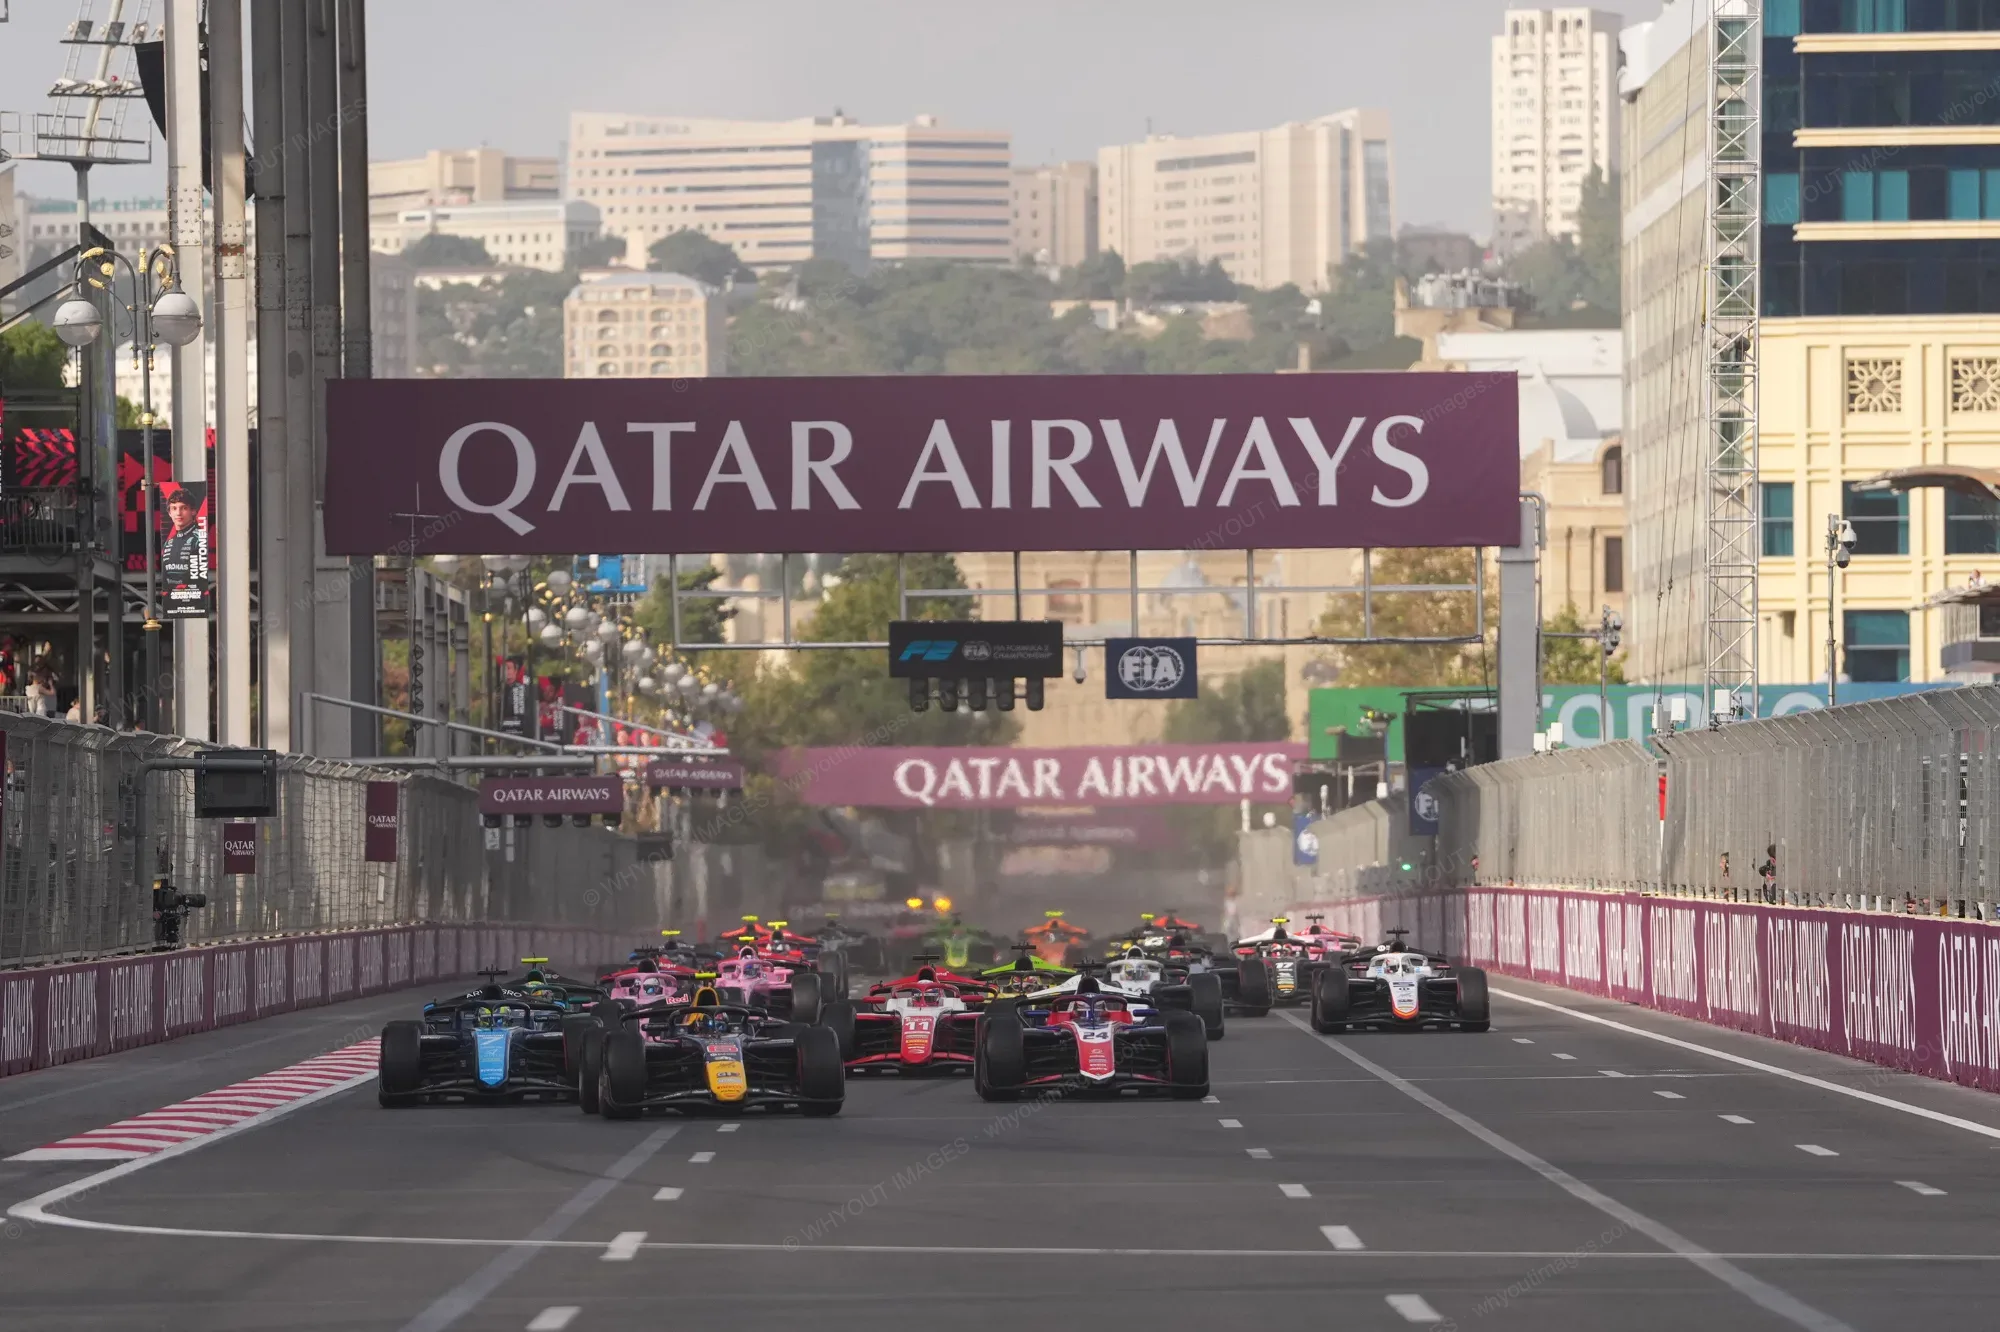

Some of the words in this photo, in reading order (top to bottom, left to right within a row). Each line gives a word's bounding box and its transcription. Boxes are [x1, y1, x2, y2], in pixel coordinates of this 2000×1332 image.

[440, 421, 860, 536] QATAR
[898, 414, 1429, 510] AIRWAYS
[190, 554, 199, 579] KIMI
[198, 516, 208, 580] ANTONELLI
[493, 788, 543, 803] QATAR
[547, 787, 610, 801] AIRWAYS
[894, 757, 1063, 806] QATAR
[1077, 753, 1290, 798] AIRWAYS
[368, 815, 397, 824] QATAR
[224, 840, 255, 851] QATAR
[1704, 910, 1728, 1019] QATAR
[1767, 916, 1795, 1034] QATAR
[1795, 919, 1830, 1033] AIRWAYS
[666, 994, 689, 1004] Red
[1841, 922, 1874, 1052] QATAR
[1875, 926, 1916, 1051] AIRWAYS
[1939, 932, 1981, 1075] QATAR
[905, 1021, 928, 1031] 11
[1082, 1031, 1109, 1040] 24
